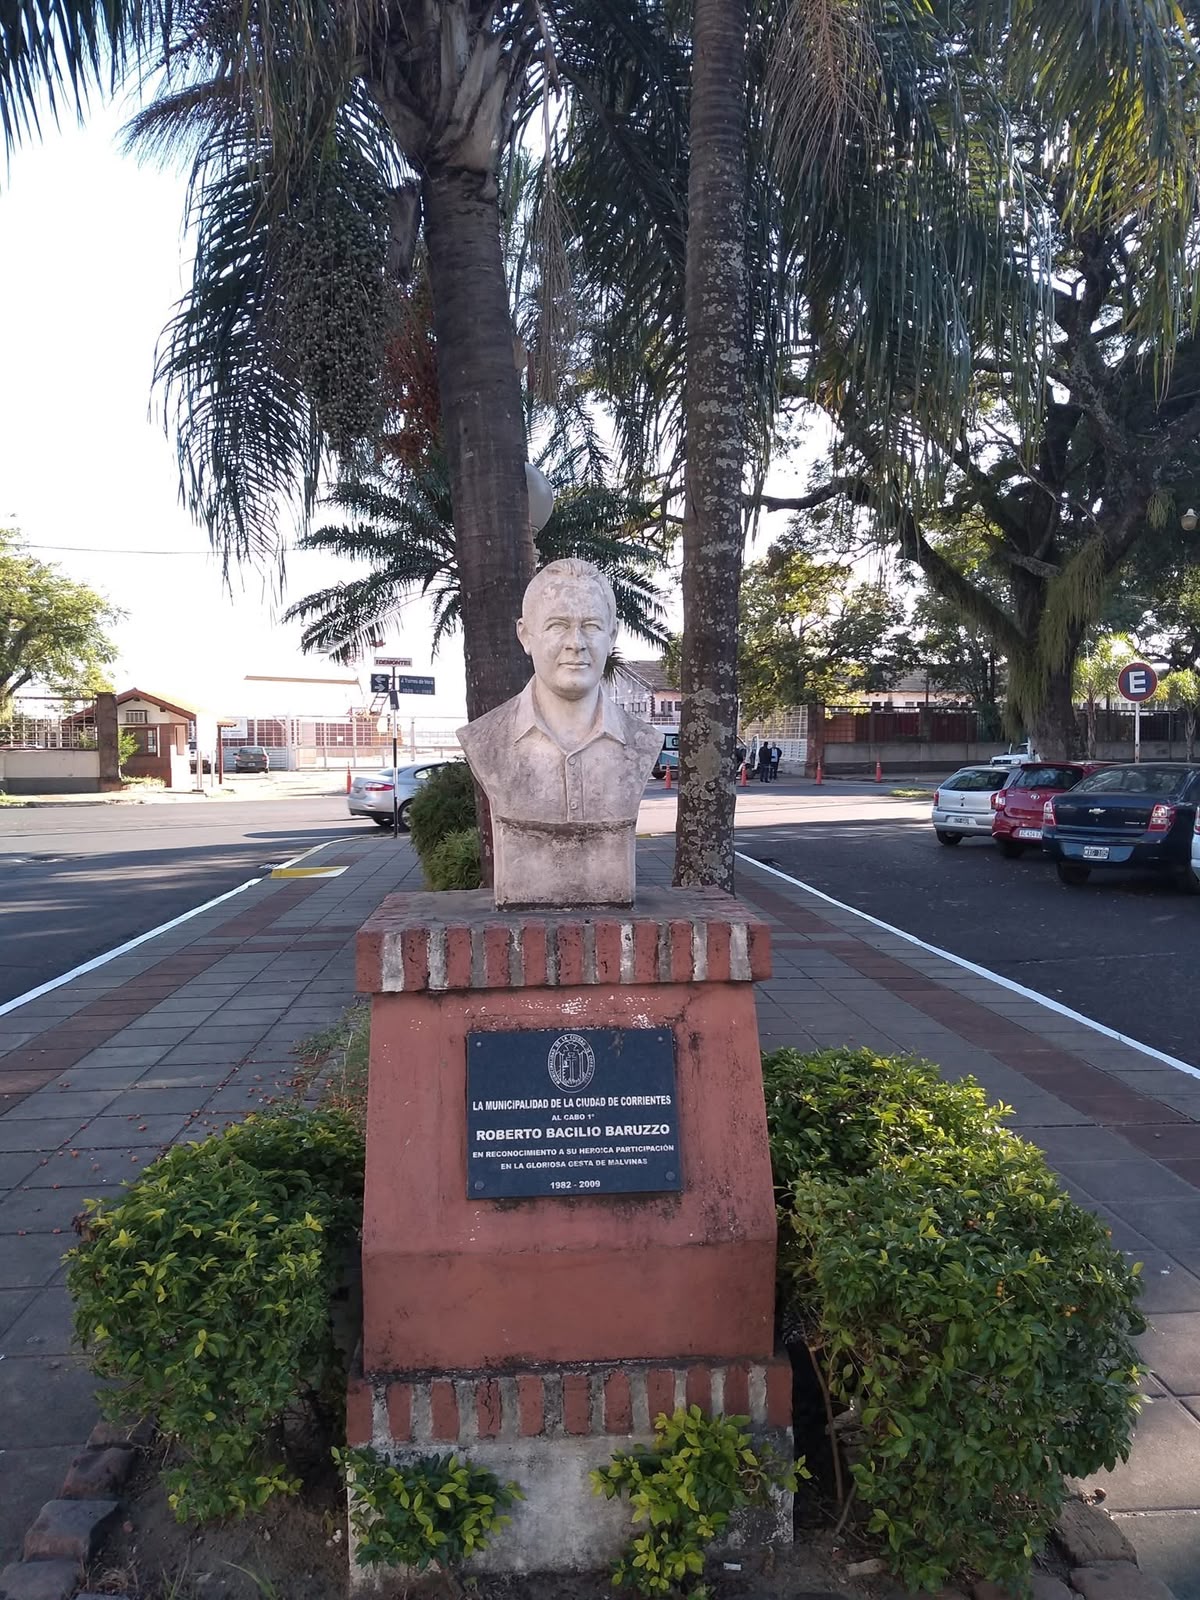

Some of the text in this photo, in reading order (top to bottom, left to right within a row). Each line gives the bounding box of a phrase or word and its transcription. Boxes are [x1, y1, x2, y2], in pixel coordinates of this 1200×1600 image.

[1129, 671, 1146, 693] E
[473, 1095, 671, 1111] LA MUNICIPALIDAD DE LA CIUDAD DE CORRIENTES
[476, 1124, 670, 1141] ROBERTO BACILIO BARUZZO
[485, 1148, 557, 1158] RECONOCIMIENTO
[579, 1146, 614, 1154] HEROICA
[526, 1160, 566, 1169] GLORIOSA
[569, 1160, 594, 1168] GESTA
[608, 1158, 647, 1166] MALVINAS
[550, 1181, 571, 1189] 1982
[579, 1180, 600, 1188] 2009
